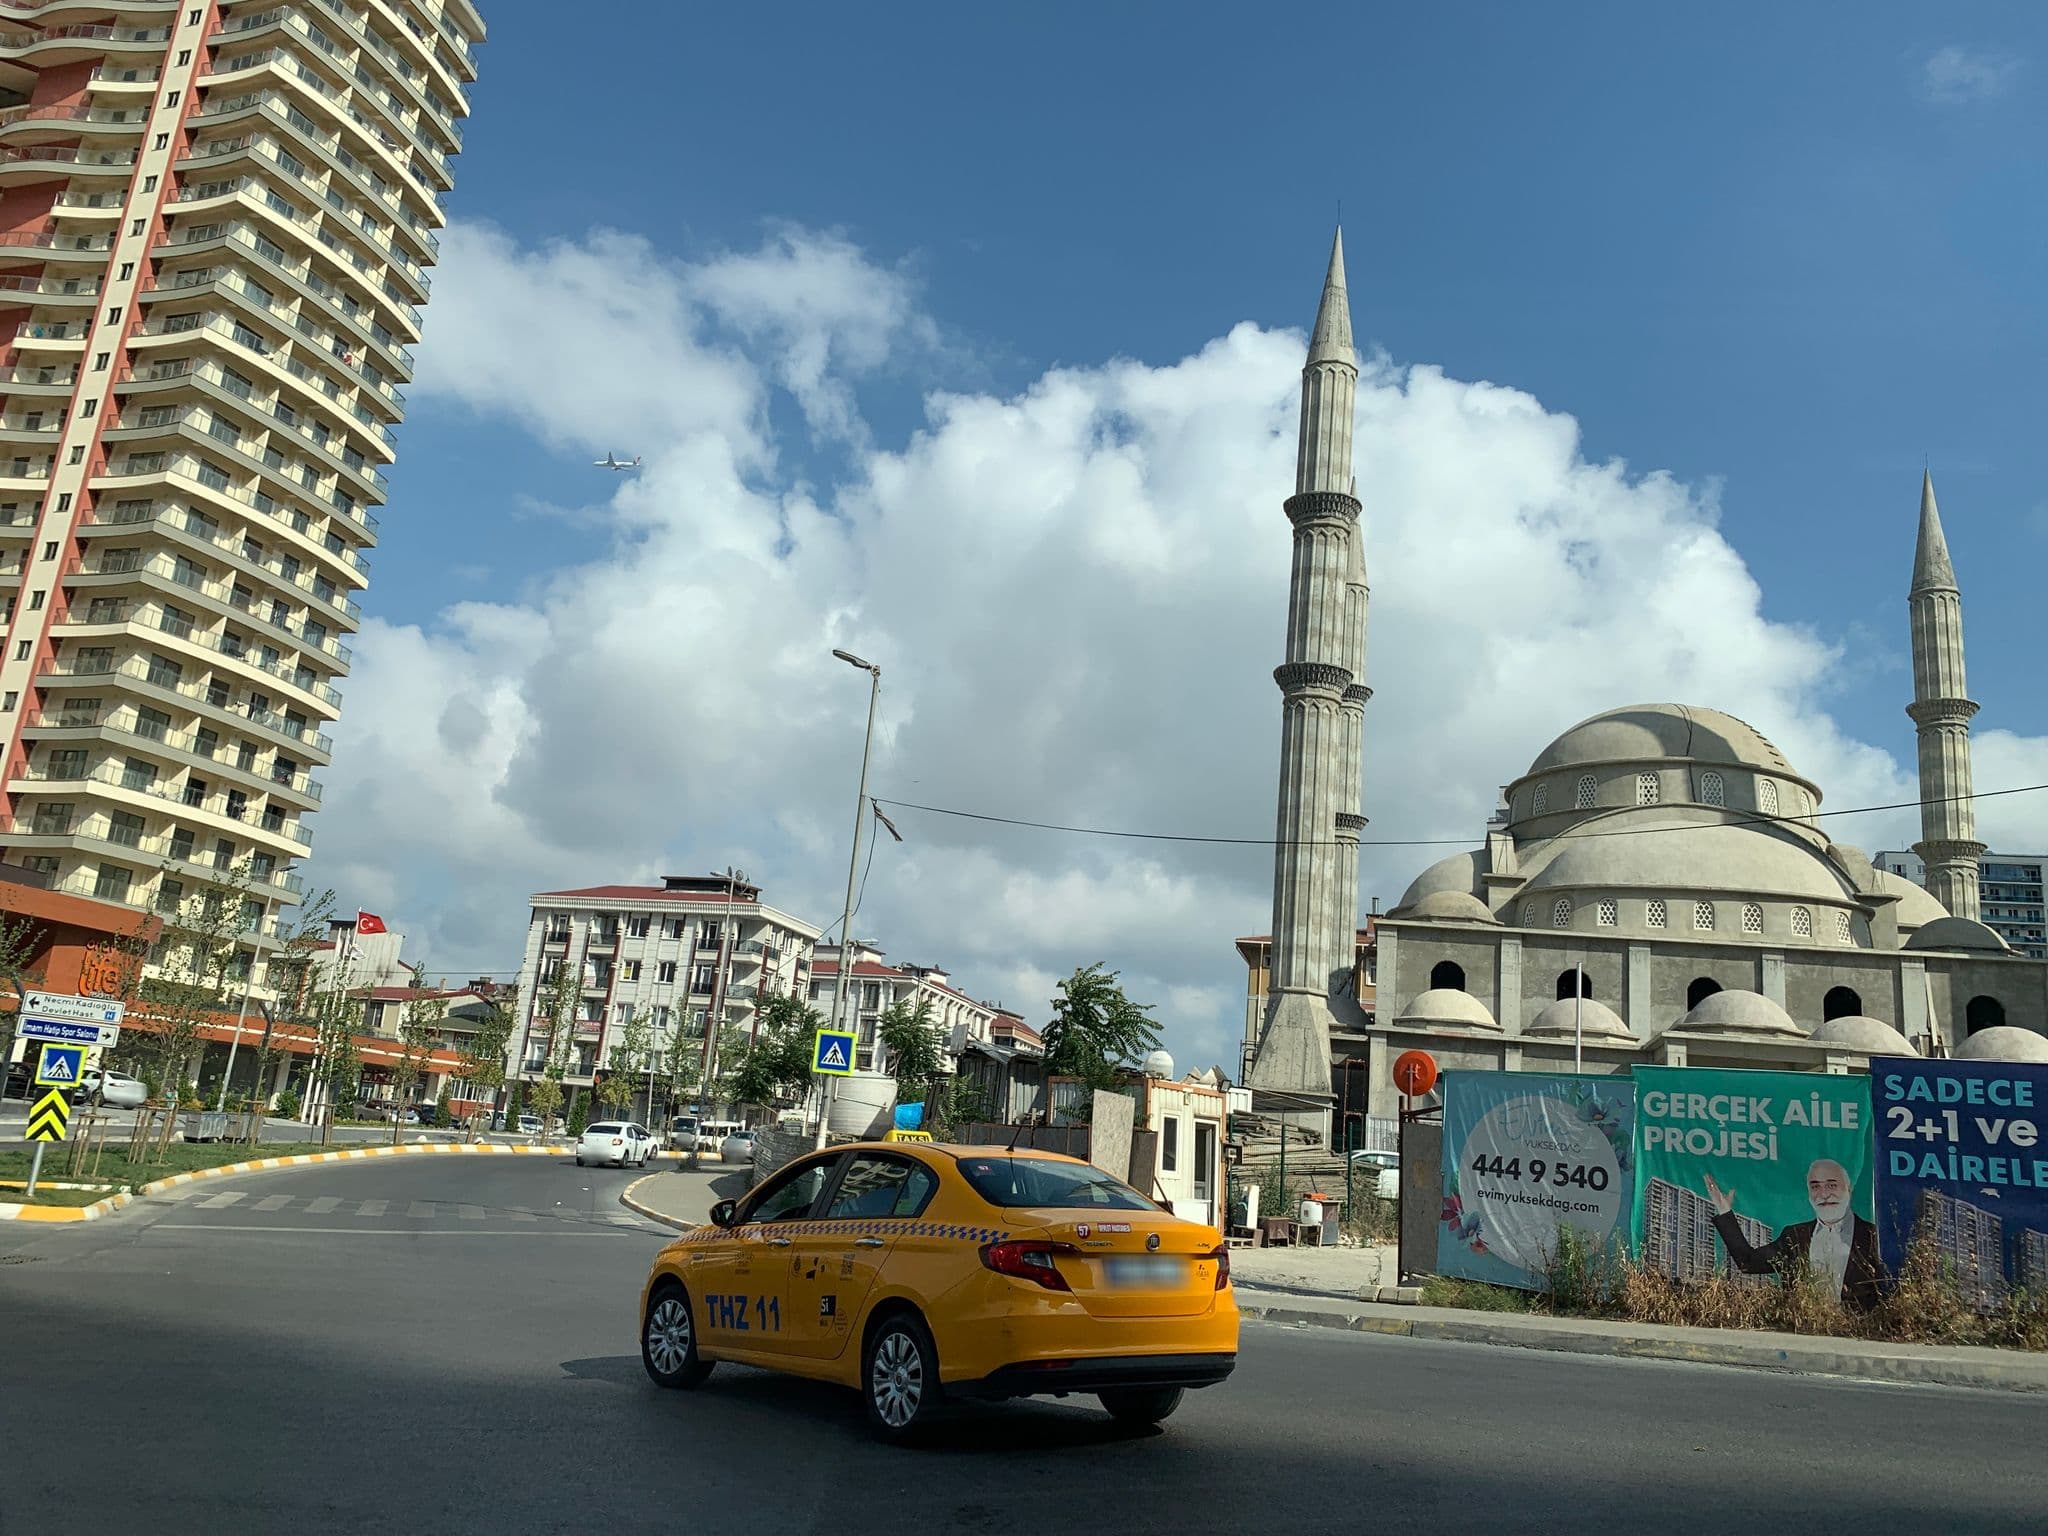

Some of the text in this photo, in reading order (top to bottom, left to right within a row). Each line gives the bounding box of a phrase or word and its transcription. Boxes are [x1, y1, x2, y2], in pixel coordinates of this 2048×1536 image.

[42, 1005, 94, 1018] Devlet Hast
[44, 995, 74, 1006] Necmi
[43, 1024, 61, 1036] Hatip
[61, 1026, 76, 1038] Spor
[76, 1028, 99, 1039] Salonu
[1884, 1074, 2034, 1108] SADECE
[1643, 1090, 1859, 1129] GERÇEK AİLE
[1886, 1105, 2039, 1148] 2+1 ve
[1643, 1125, 1779, 1161] PROJESİ
[1471, 1153, 1609, 1192] 444 9 540
[1889, 1145, 2048, 1189] DAİRELE
[1477, 1187, 1600, 1214] evimyuksekdag.com
[1078, 1225, 1089, 1237] 57
[705, 1295, 780, 1332] THZ 11
